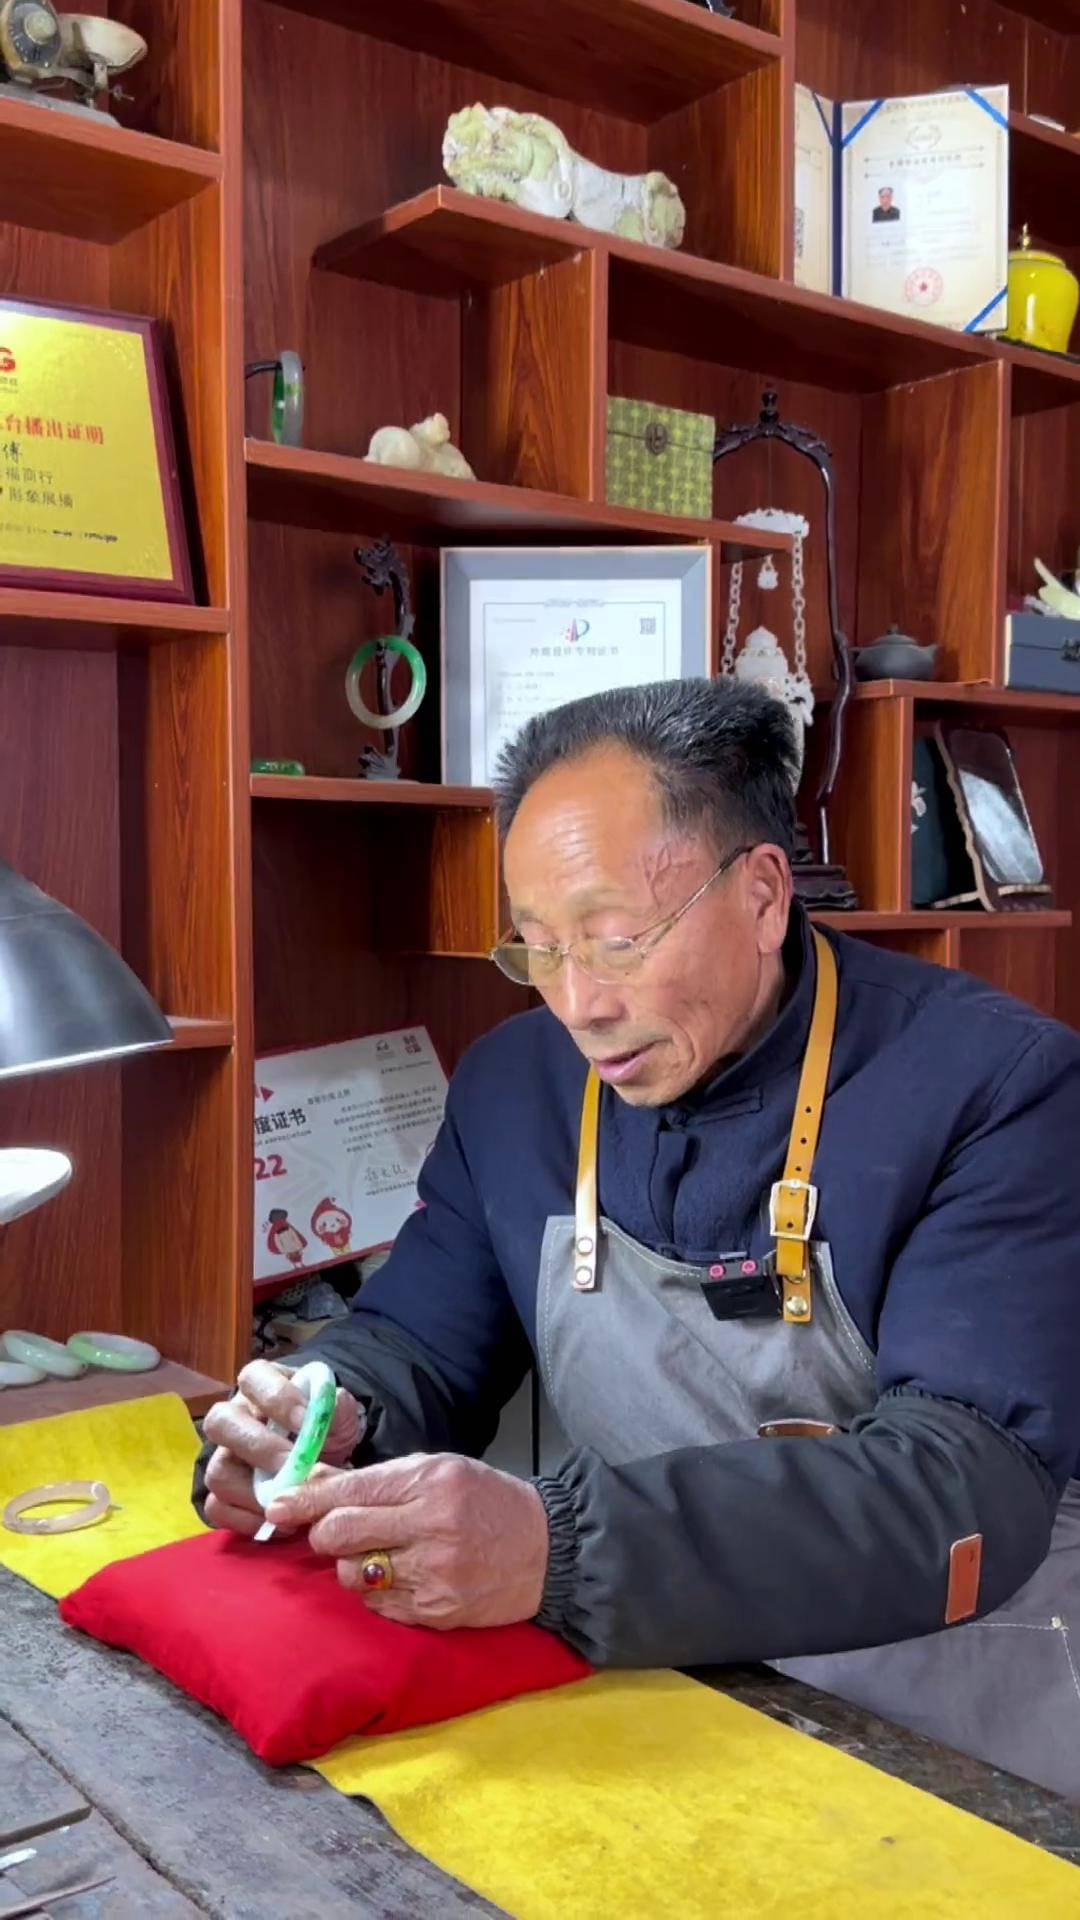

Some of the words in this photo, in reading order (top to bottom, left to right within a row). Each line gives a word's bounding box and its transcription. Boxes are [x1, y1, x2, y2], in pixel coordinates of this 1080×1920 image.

[0, 413, 104, 445] 台播出证明
[0, 486, 73, 509] 形象展播
